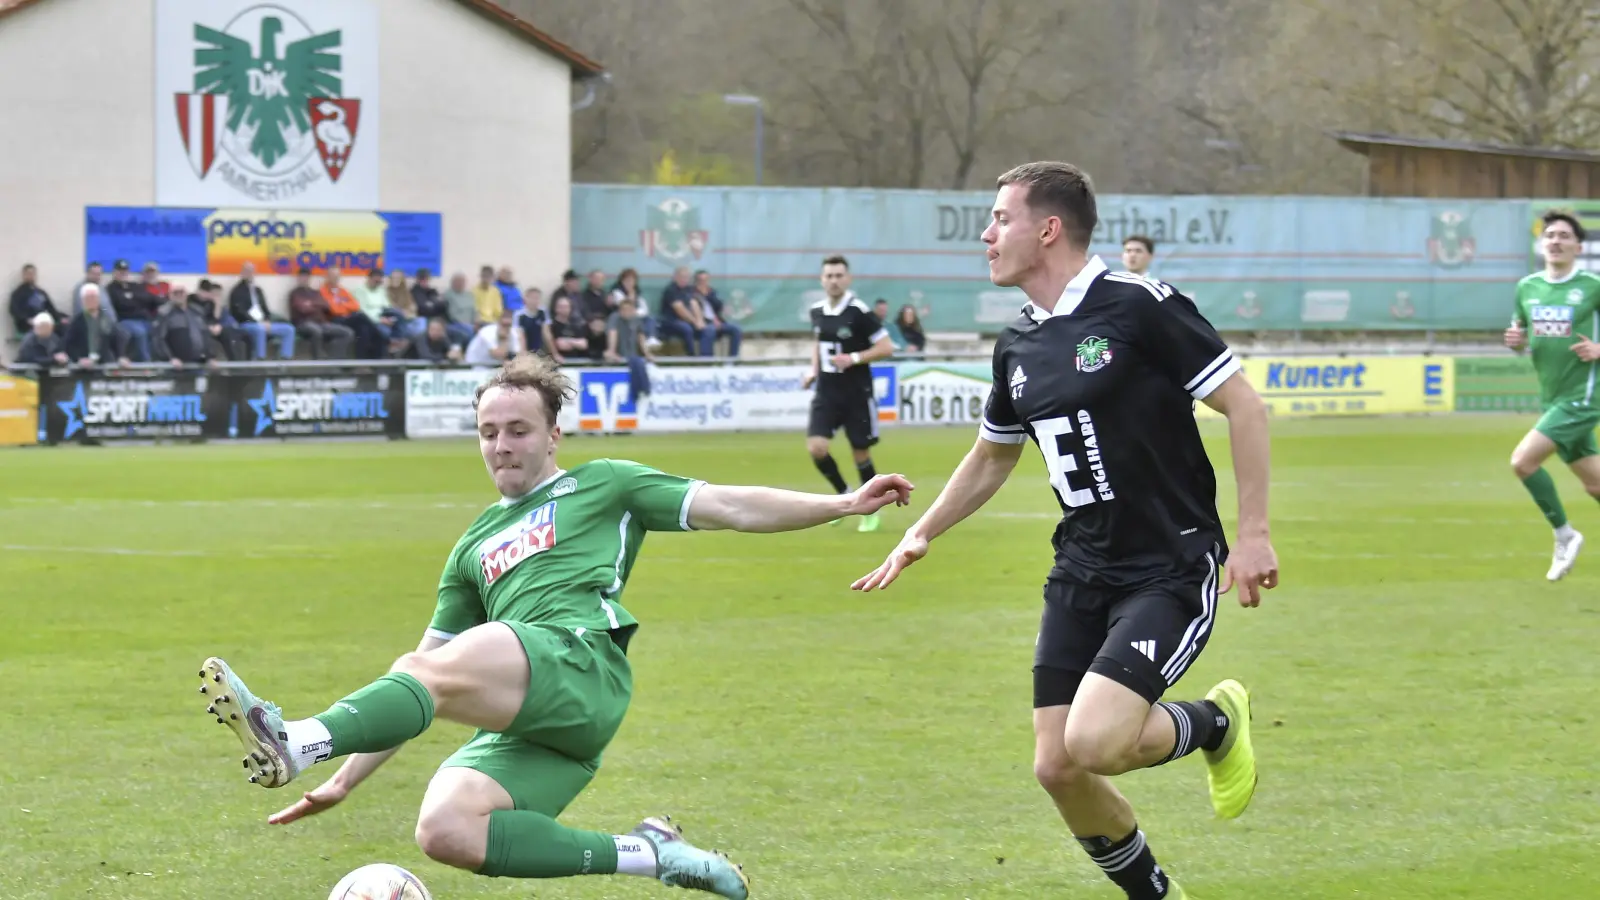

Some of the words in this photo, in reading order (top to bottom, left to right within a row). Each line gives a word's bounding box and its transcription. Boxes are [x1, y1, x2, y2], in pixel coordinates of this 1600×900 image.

[217, 160, 322, 202] AMMERTHAL
[208, 218, 306, 246] propan
[1092, 206, 1180, 243] erthal
[1186, 208, 1234, 244] e.V.
[1266, 362, 1366, 388] Kunert
[1011, 384, 1025, 400] 47
[646, 400, 708, 425] Amberg
[1077, 409, 1115, 501] ENGLHARD
[485, 524, 553, 581] MOLY
